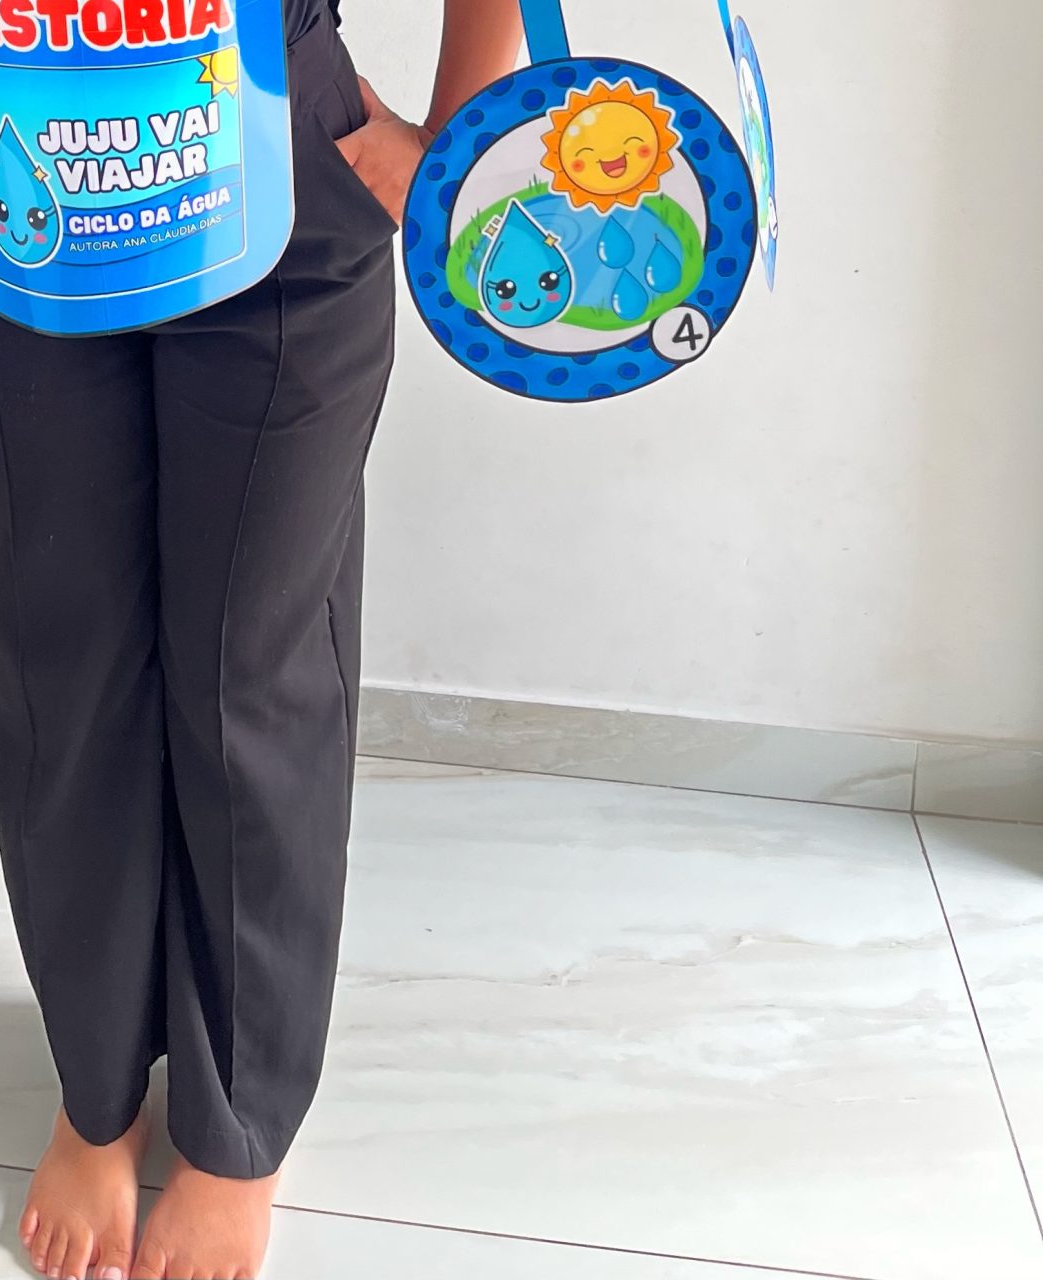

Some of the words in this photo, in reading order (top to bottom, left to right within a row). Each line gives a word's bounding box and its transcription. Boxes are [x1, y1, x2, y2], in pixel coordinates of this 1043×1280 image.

[38, 118, 138, 154] JUJU
[150, 101, 220, 146] VAI
[55, 145, 209, 194] VIAJAR
[68, 212, 134, 234] CICLO
[140, 206, 172, 229] DA
[177, 187, 231, 220] ÁGUA
[69, 240, 119, 252] AUTORA
[123, 236, 147, 248] ANA
[150, 223, 197, 244] CLÁUDIA
[199, 213, 222, 230] DIAS
[672, 312, 704, 351] 4
